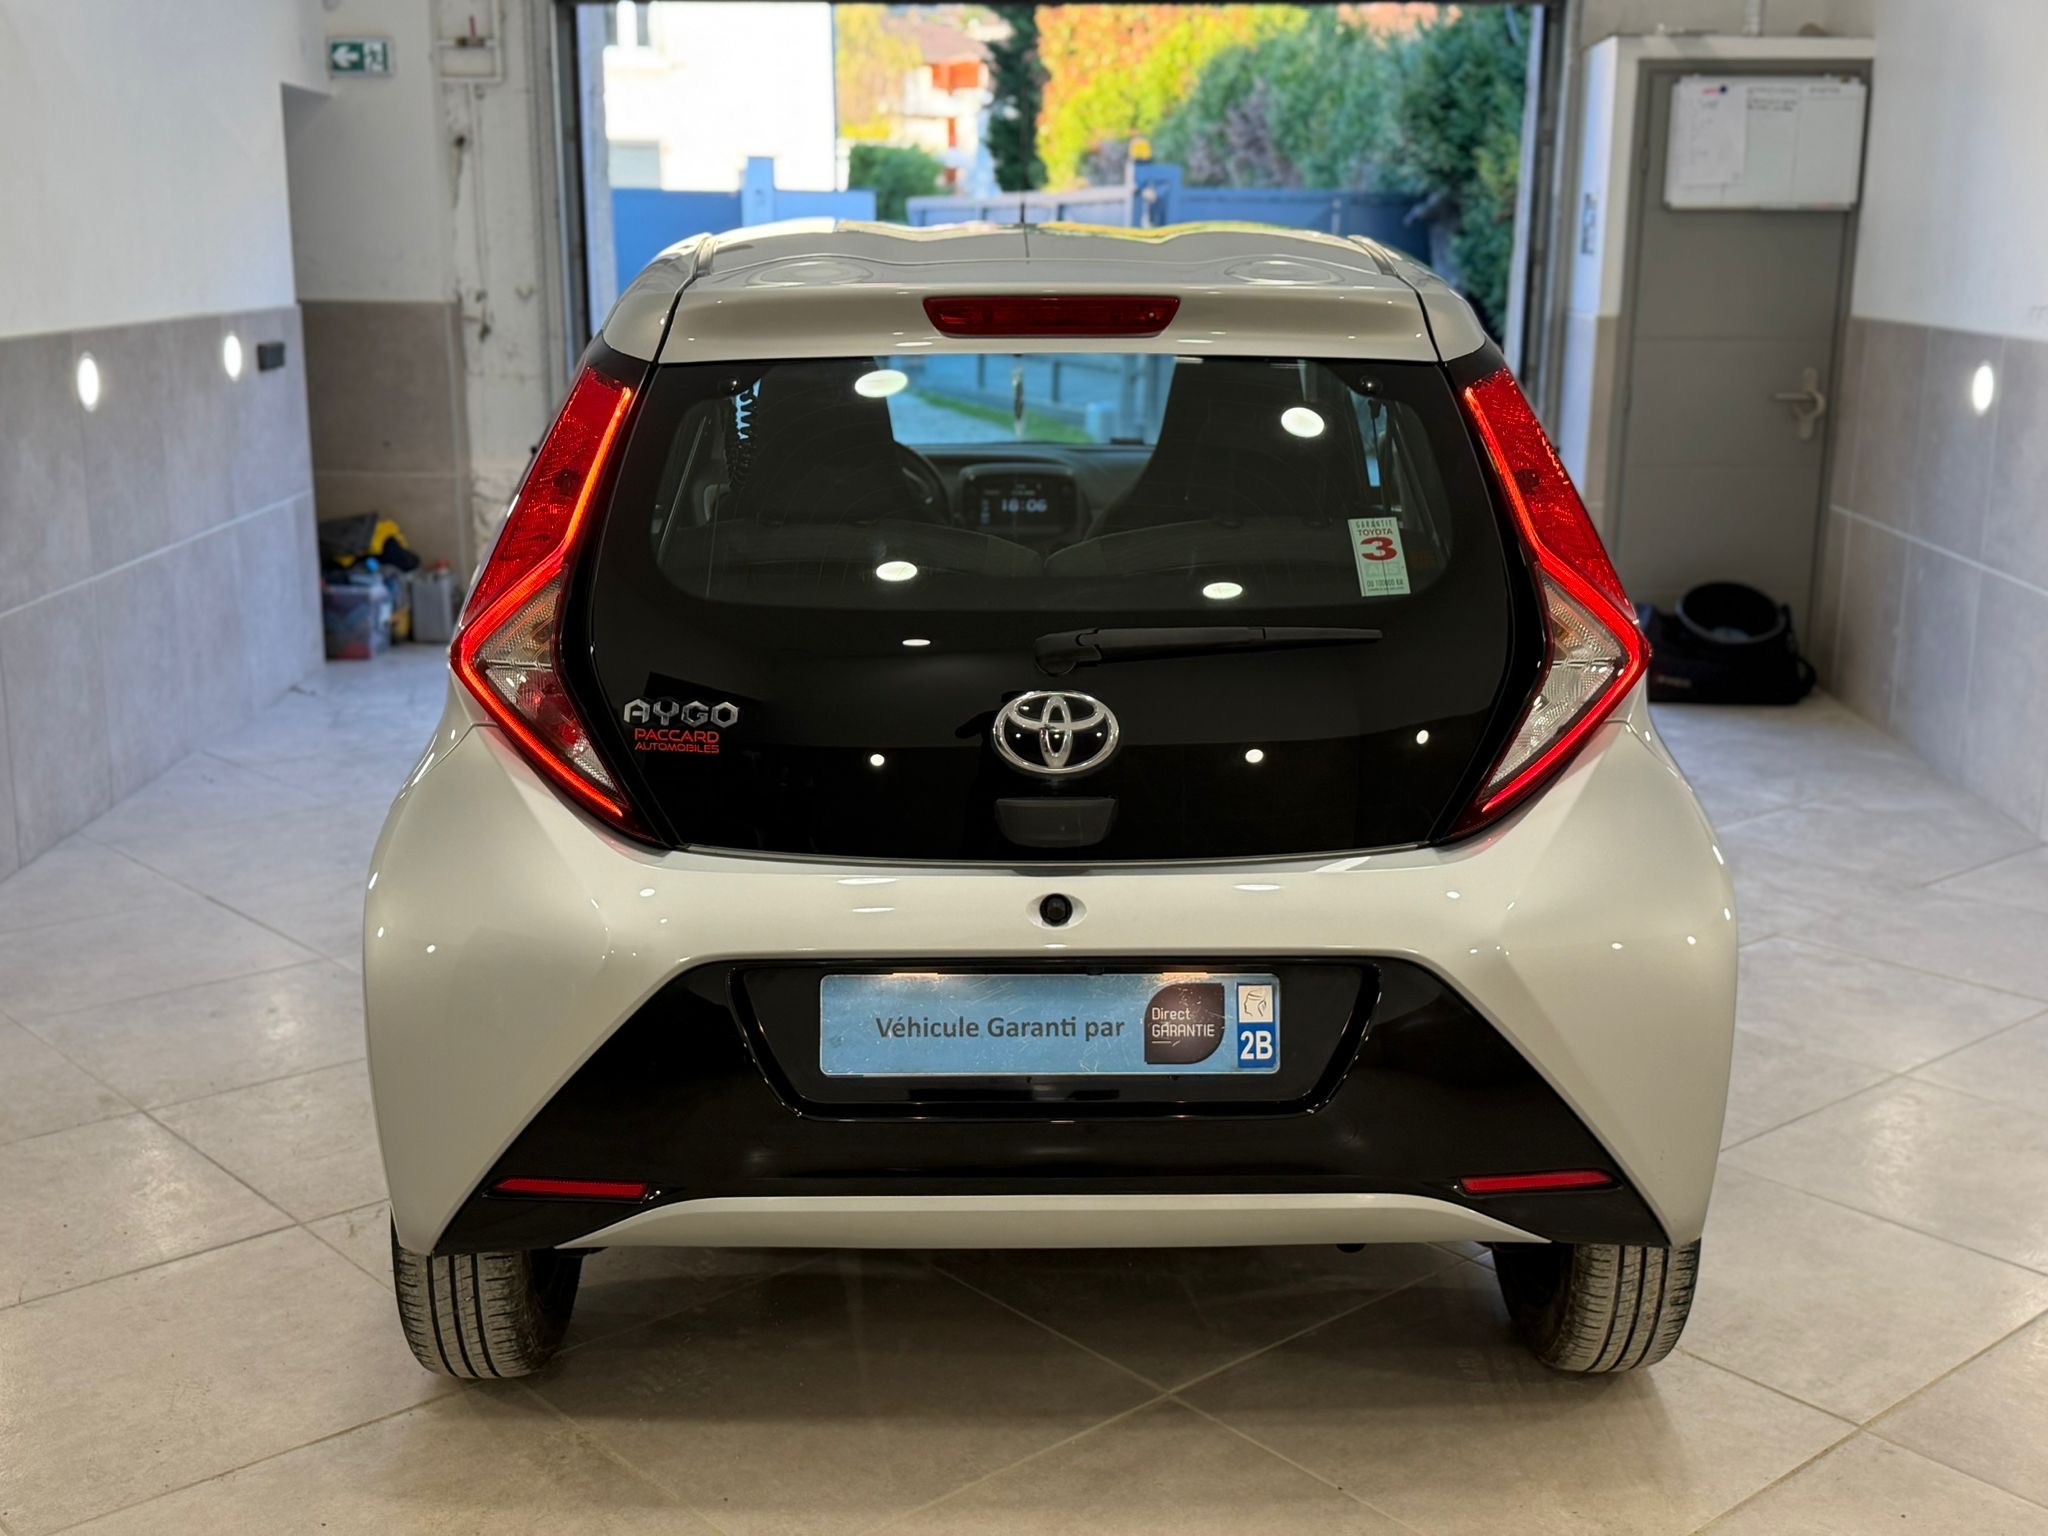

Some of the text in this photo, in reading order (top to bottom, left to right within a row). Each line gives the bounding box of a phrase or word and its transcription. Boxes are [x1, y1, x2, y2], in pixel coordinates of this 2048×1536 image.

[1358, 528, 1393, 536] TOYOTA
[1360, 536, 1398, 561] 3
[623, 698, 739, 728] AYGO
[634, 728, 720, 743] PACCARD
[634, 741, 720, 754] AUTOMOBILES
[1151, 1007, 1192, 1021] Direct
[876, 1016, 1125, 1041] Véhicule Garanti par
[1151, 1023, 1215, 1037] GARANTIE
[1240, 1030, 1274, 1060] 2B
